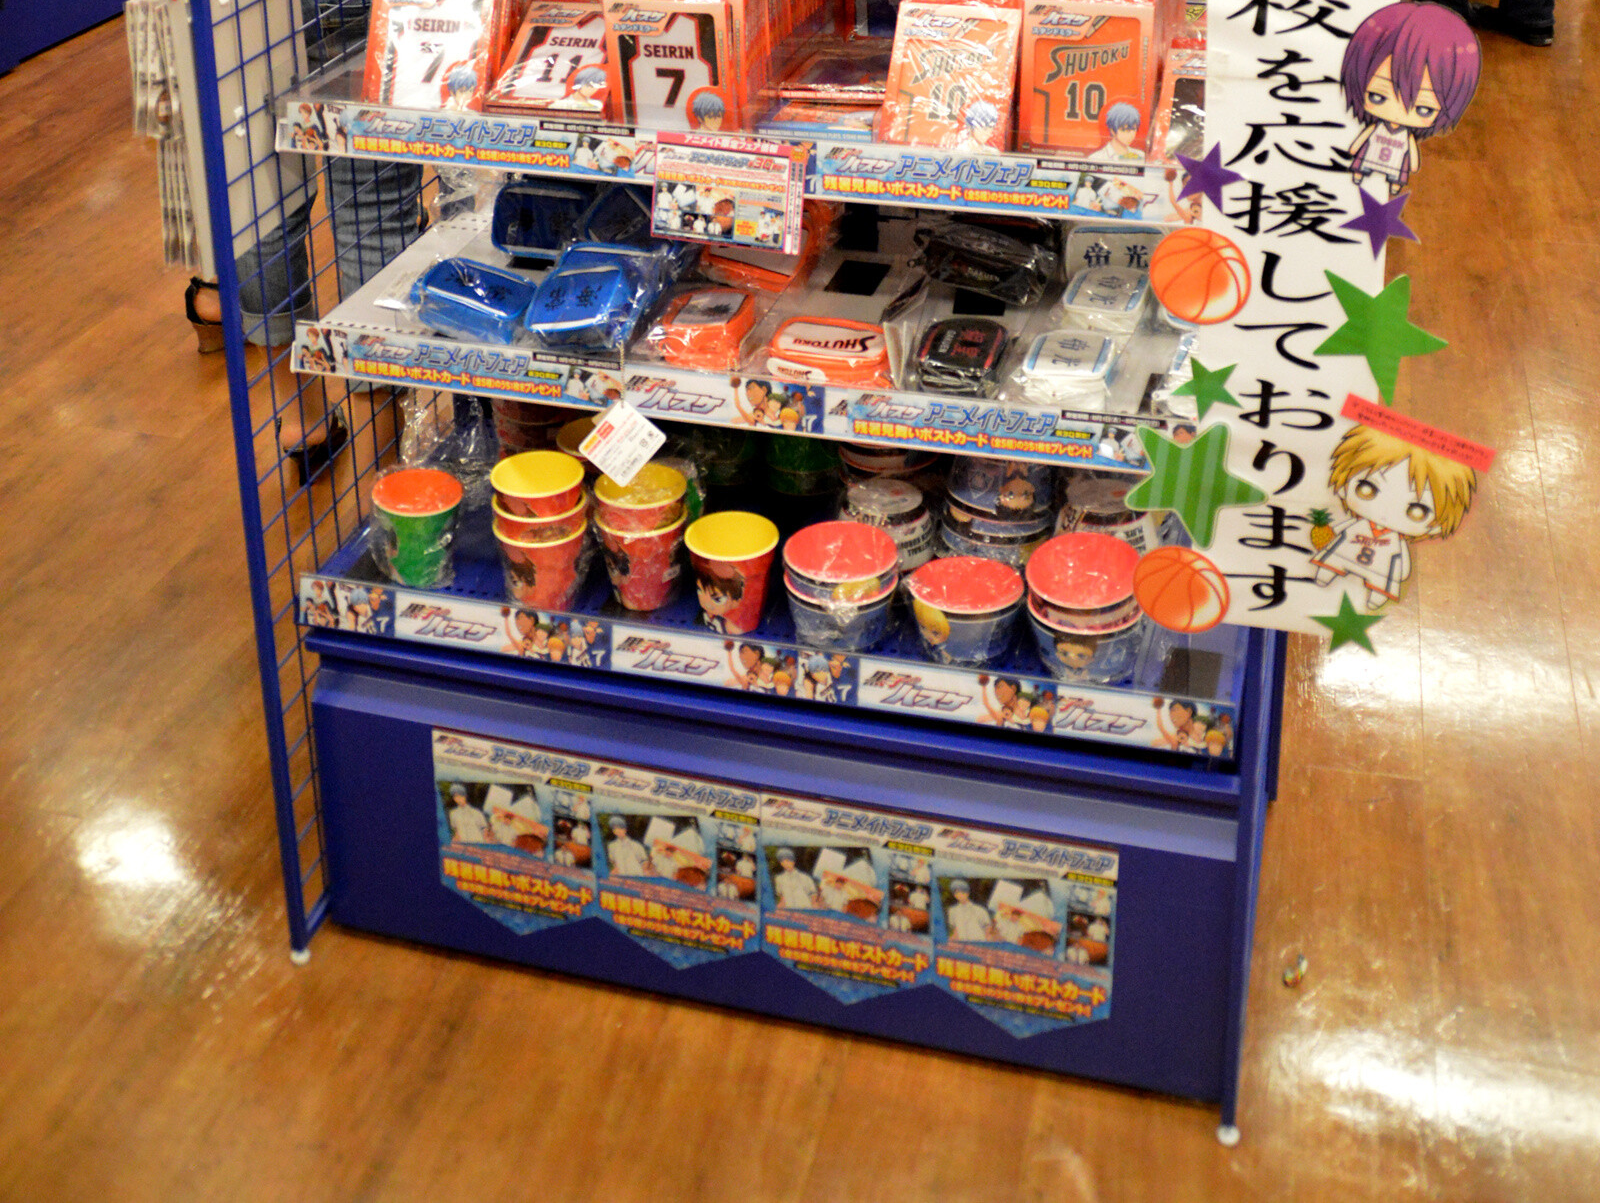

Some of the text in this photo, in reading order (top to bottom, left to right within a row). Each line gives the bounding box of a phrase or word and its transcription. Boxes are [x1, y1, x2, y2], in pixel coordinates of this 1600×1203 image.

[413, 17, 462, 34] SEIRIN
[549, 35, 599, 49] SEIRIN
[642, 43, 695, 60] SEIRIN
[911, 42, 994, 85] SHUTOKU
[1044, 39, 1133, 85] SHUTOKU
[654, 67, 686, 108] 7
[926, 81, 967, 122] 10
[1065, 80, 1107, 123] 10
[415, 115, 538, 146] アニメイトフェア
[353, 136, 475, 161] 残暑見舞いポストカード
[823, 175, 963, 199] 残暑見舞いポストカード
[894, 154, 1035, 187] アニメイトフェア
[353, 358, 472, 386] 残暑見舞いポストカード
[413, 343, 530, 375] アニメイトフェア
[853, 420, 989, 447] 残暑見舞いポストカード
[924, 402, 1058, 436] アニメイトフェア
[1355, 546, 1377, 566] 8
[1056, 694, 1147, 735] 子のバスケ
[488, 746, 591, 779] アニメイトフェア
[649, 776, 759, 812] アニメイトフェア
[821, 807, 934, 843] アニメイトフェア
[999, 837, 1116, 874] アニメイトフェア
[442, 857, 593, 906] 残暑見舞いポストカード
[599, 890, 757, 939] 残暑見舞いポストカード
[765, 926, 930, 972] 残暑見舞いポストカード
[936, 957, 1107, 1006] 残暑見舞いポストカード
